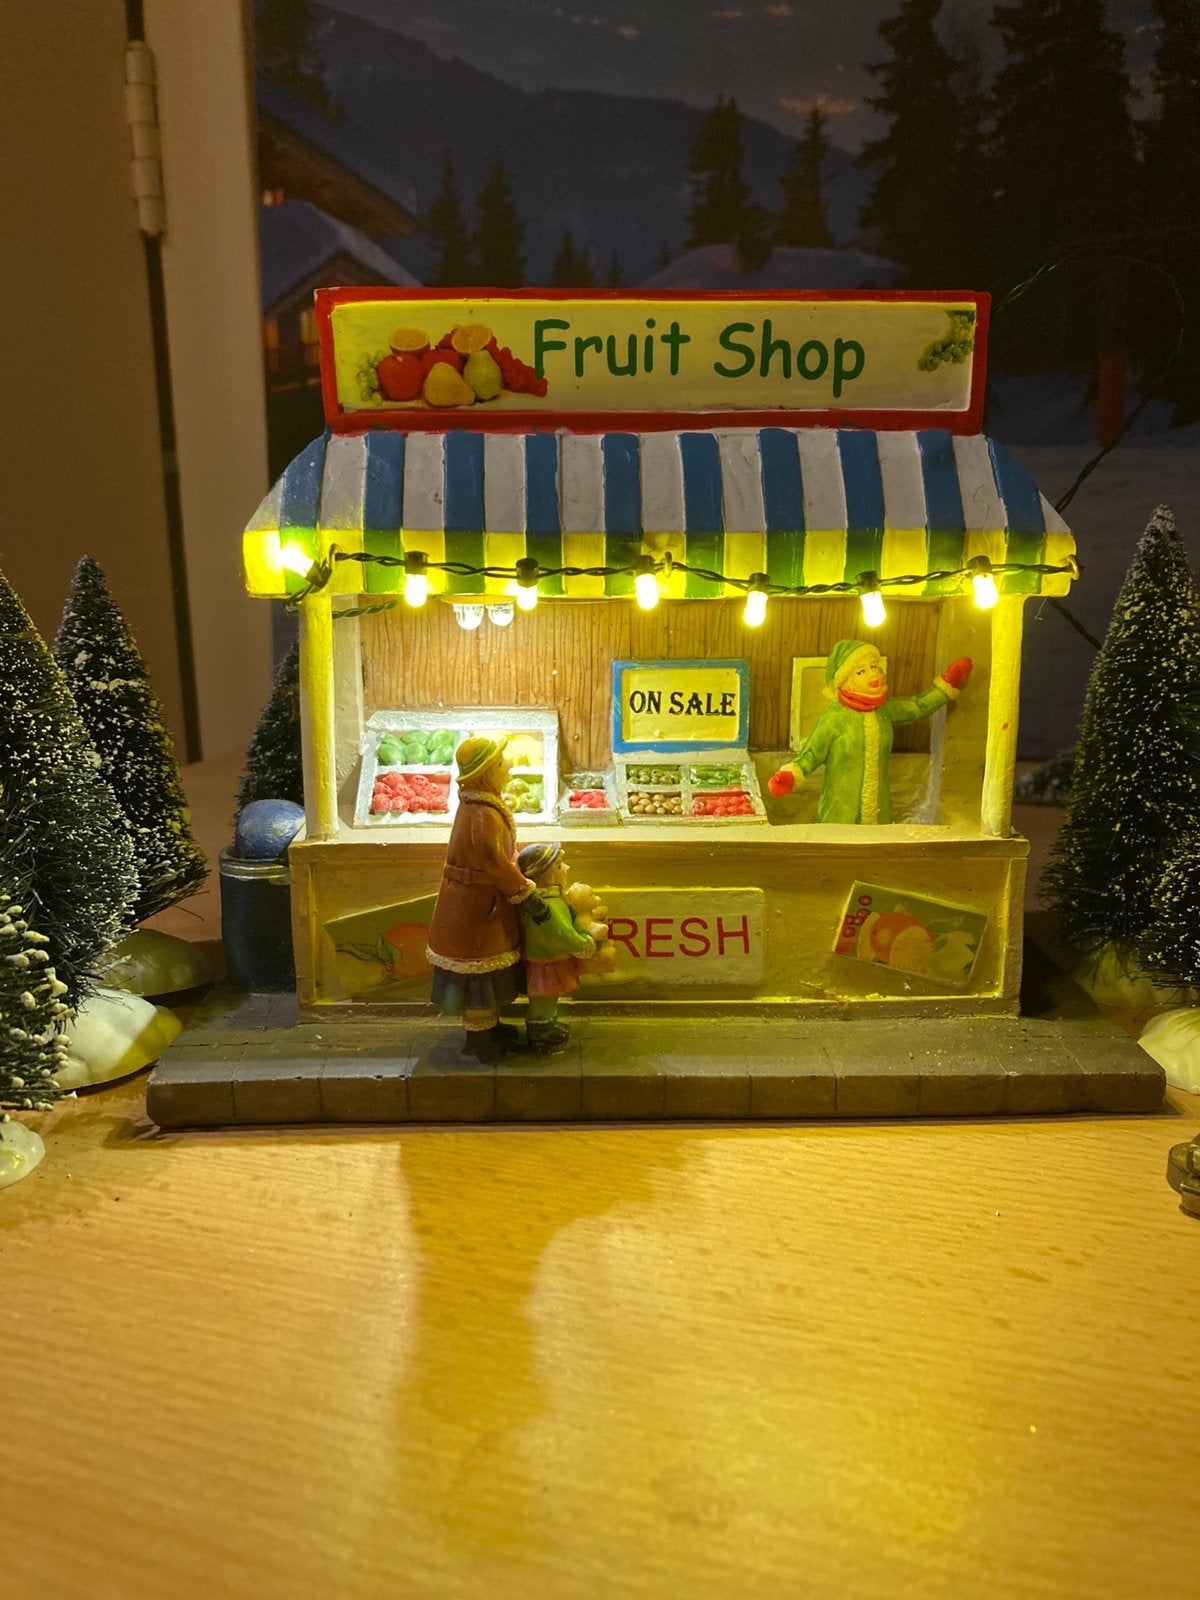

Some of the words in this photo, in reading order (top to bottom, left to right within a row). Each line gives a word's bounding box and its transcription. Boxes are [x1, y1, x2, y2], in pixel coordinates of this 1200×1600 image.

[534, 318, 691, 379] Fruit
[713, 319, 866, 397] Shop
[629, 690, 662, 714] ON
[668, 691, 737, 716] SALE
[607, 915, 750, 958] RESH
